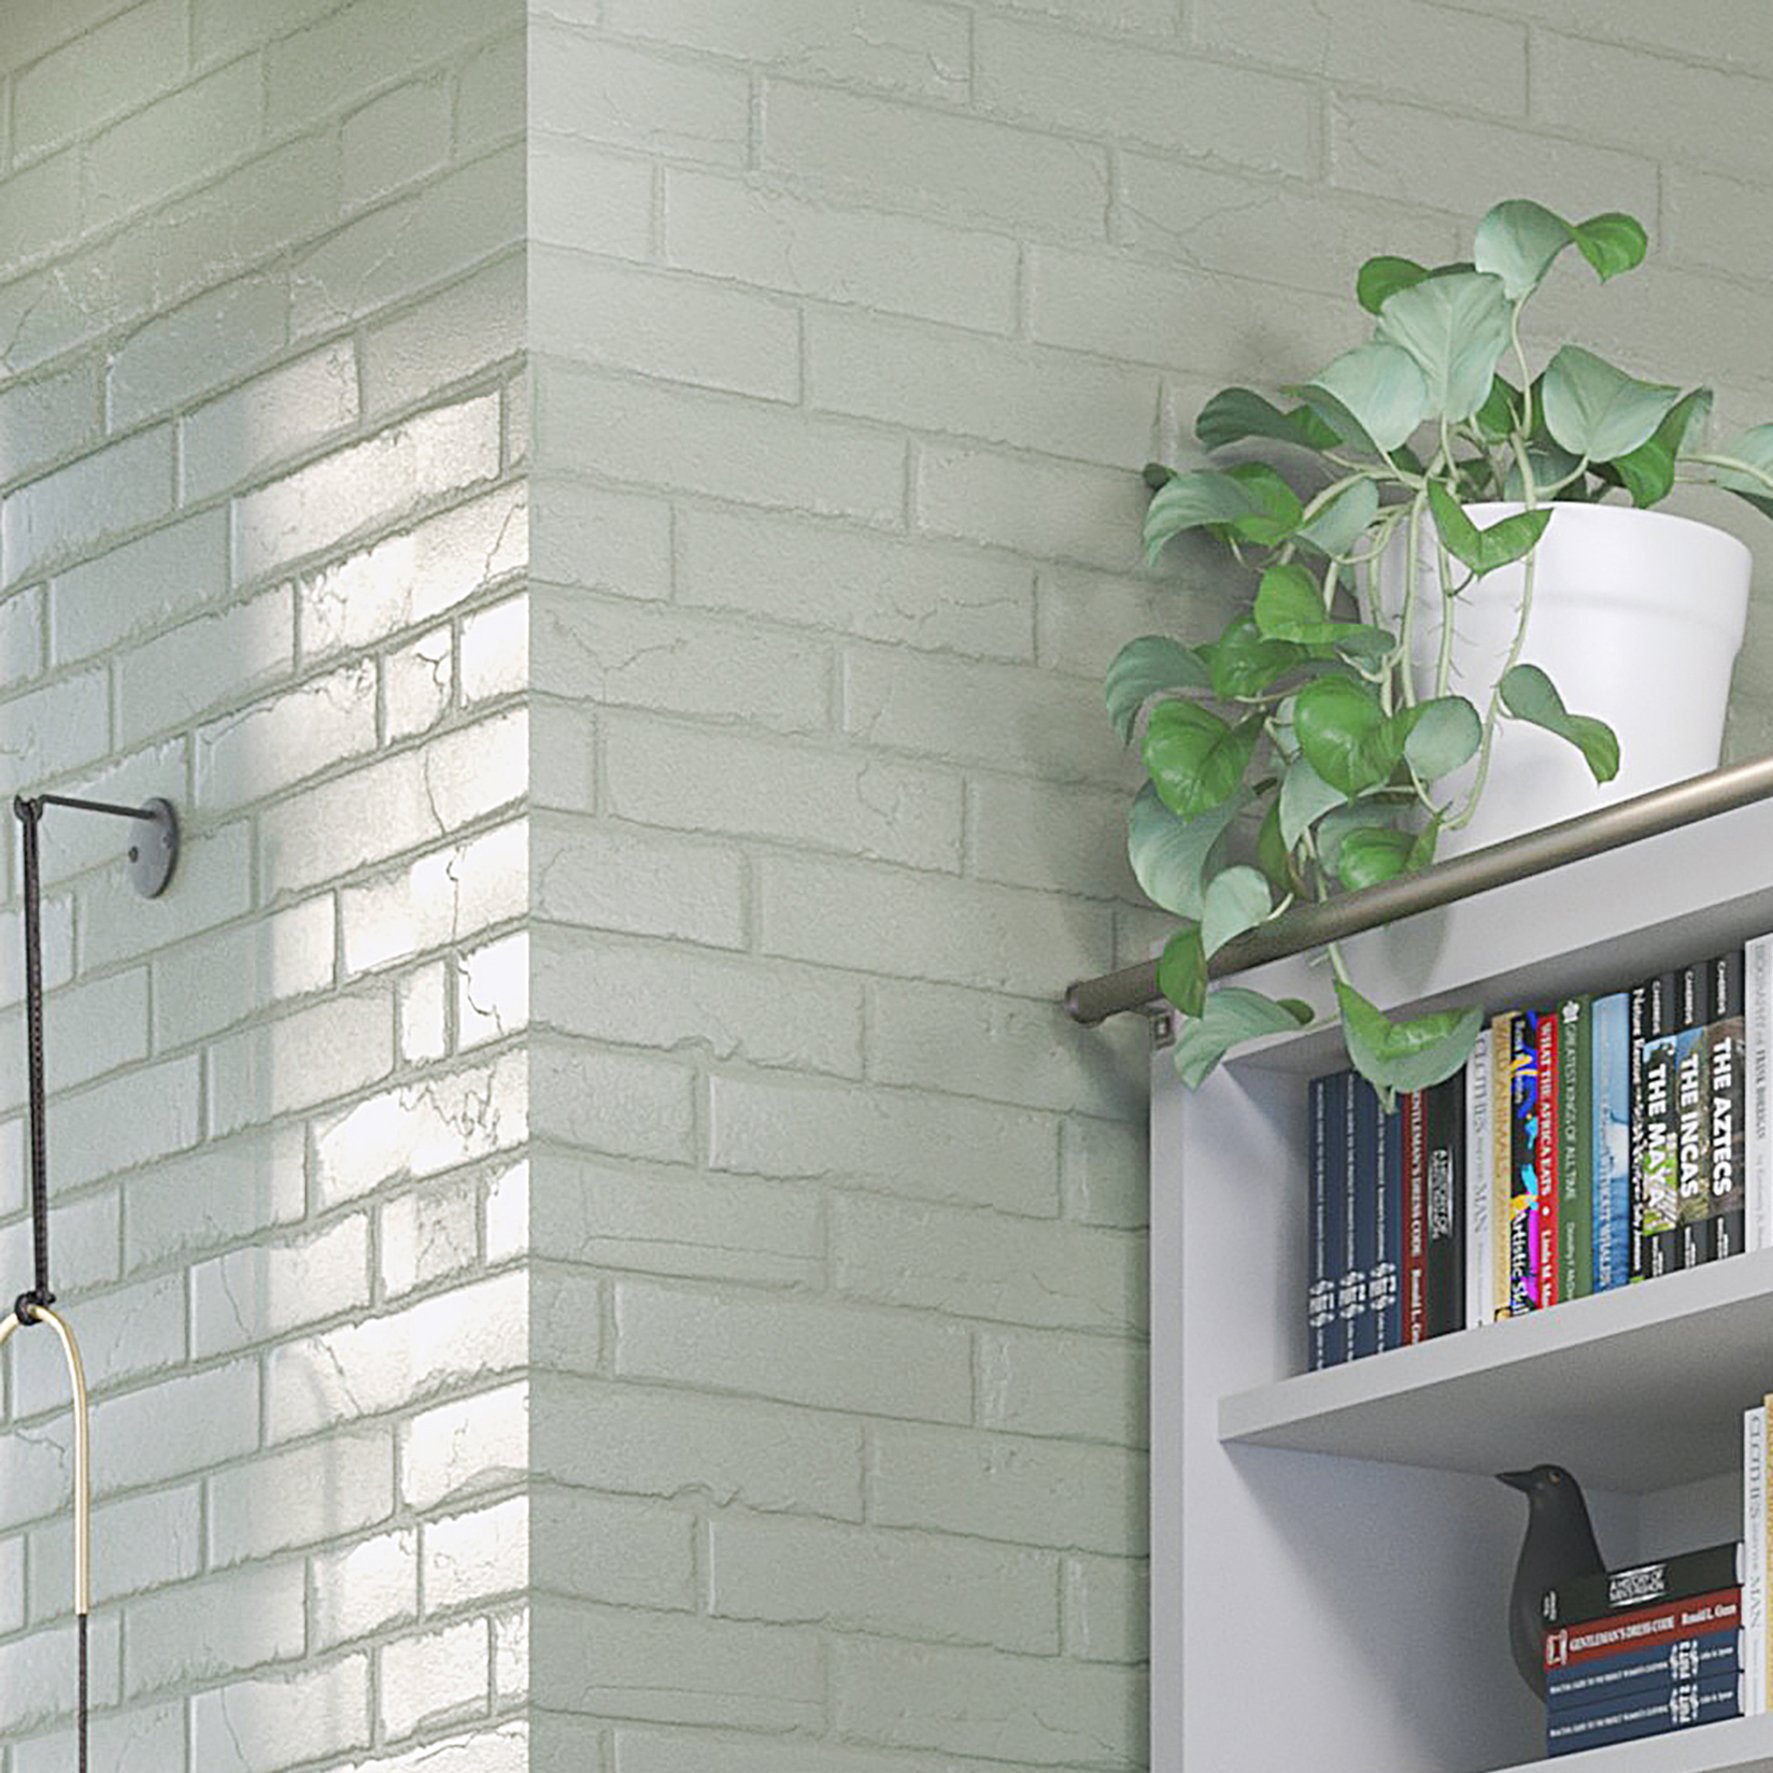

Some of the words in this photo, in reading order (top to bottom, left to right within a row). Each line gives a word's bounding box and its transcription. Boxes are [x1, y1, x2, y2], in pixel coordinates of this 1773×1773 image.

[1647, 1064, 1665, 1118] THE
[1680, 1055, 1697, 1109] THE
[1712, 1037, 1729, 1093] THE
[1647, 1124, 1665, 1209] MAYA
[1680, 1116, 1697, 1198] INCAS
[1712, 1098, 1730, 1196] AZTECS
